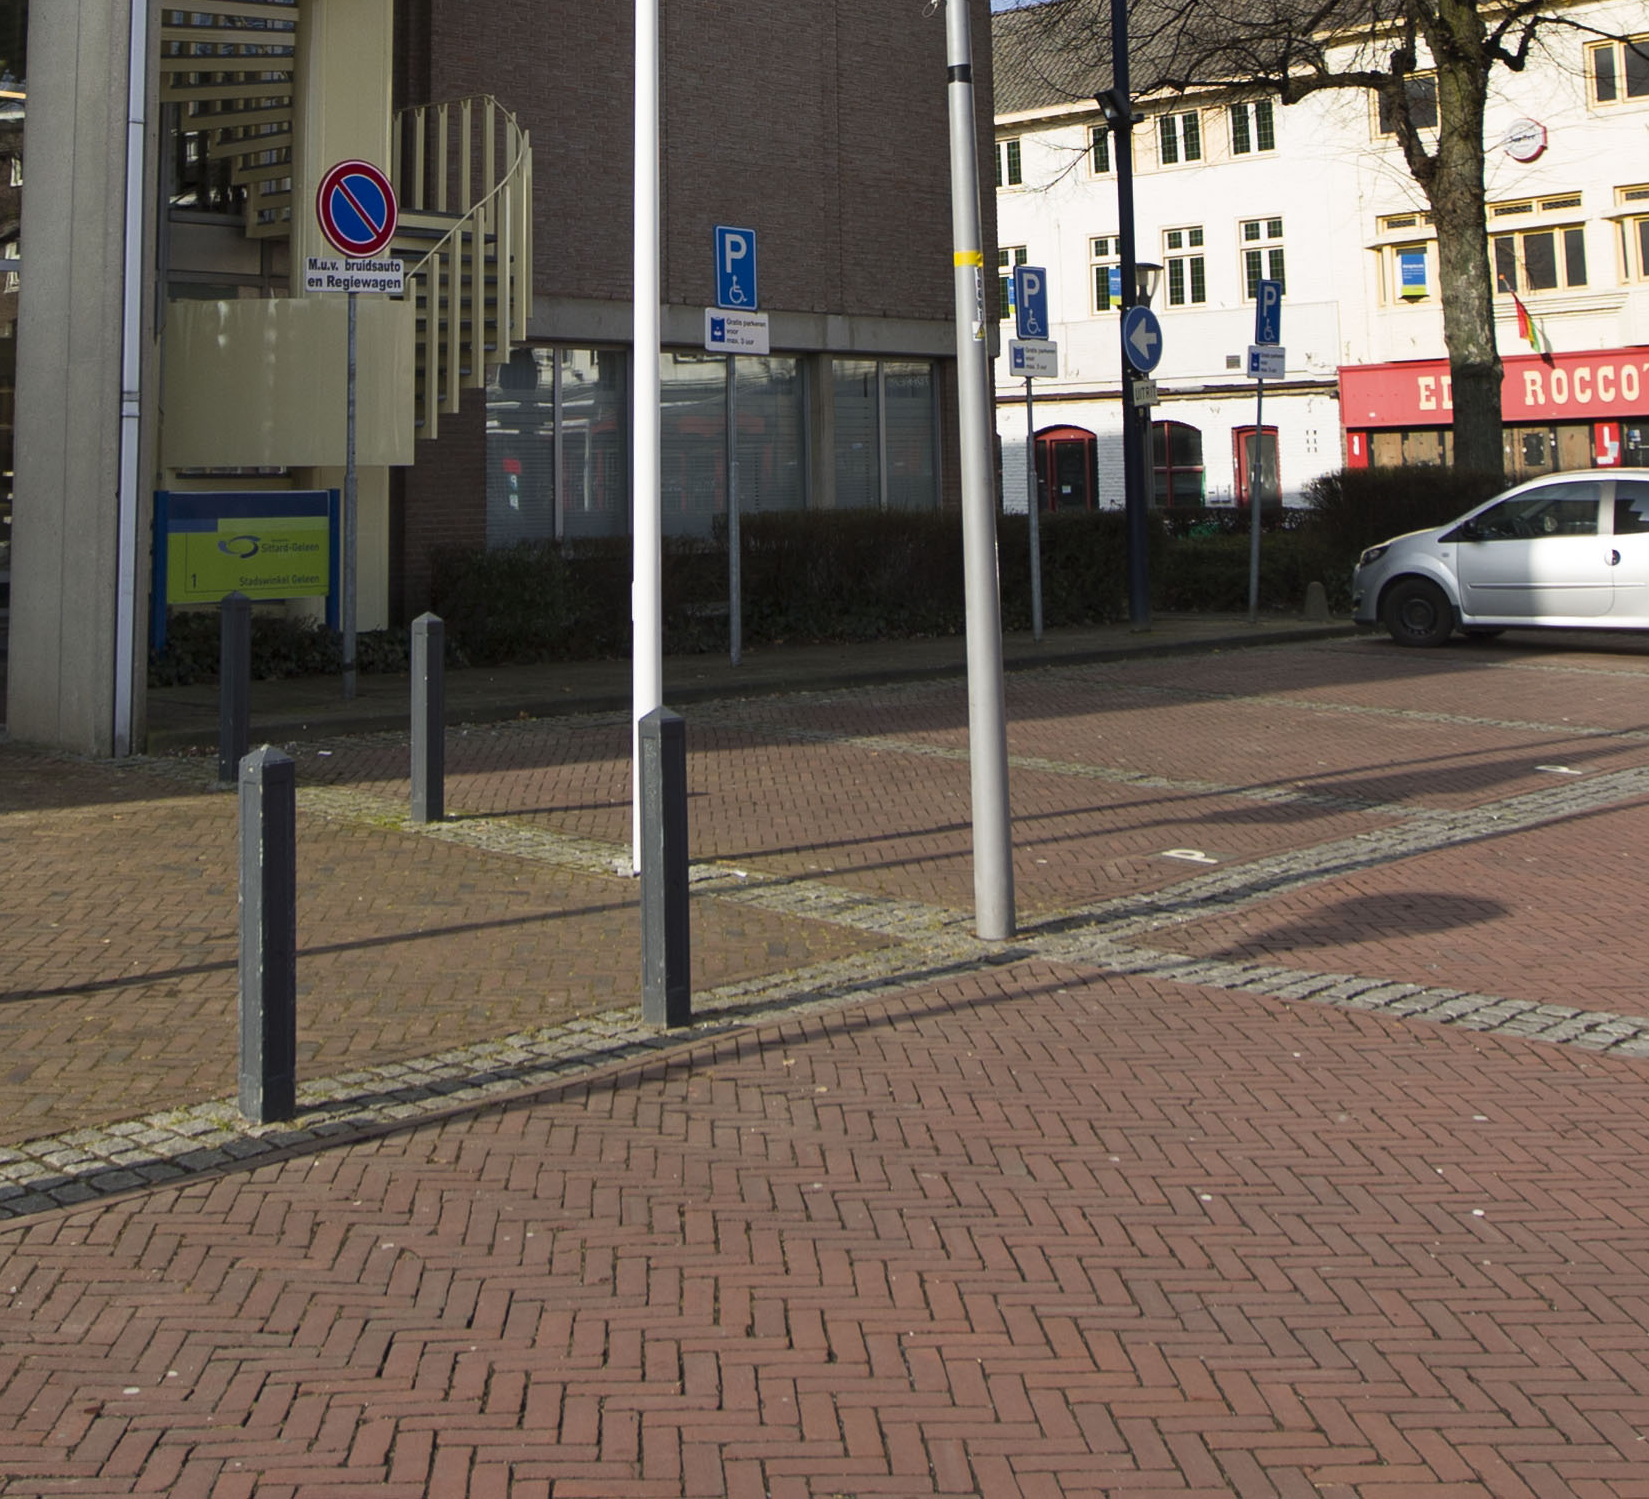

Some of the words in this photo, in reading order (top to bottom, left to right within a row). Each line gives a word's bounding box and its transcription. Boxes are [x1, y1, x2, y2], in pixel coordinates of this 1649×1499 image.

[725, 232, 747, 273] P
[308, 258, 339, 271] M.u.v.
[344, 259, 401, 272] bruidsauto
[307, 277, 323, 287] en
[326, 275, 401, 291] Regiewagen
[1022, 272, 1040, 308] P
[1263, 285, 1277, 318] P
[726, 317, 743, 327] Gratis
[743, 320, 767, 329] parkeren
[261, 542, 320, 552] Sittard-Geleen
[191, 573, 197, 589] 1
[239, 575, 289, 587] Stadswinkel
[291, 574, 320, 584] Geleen
